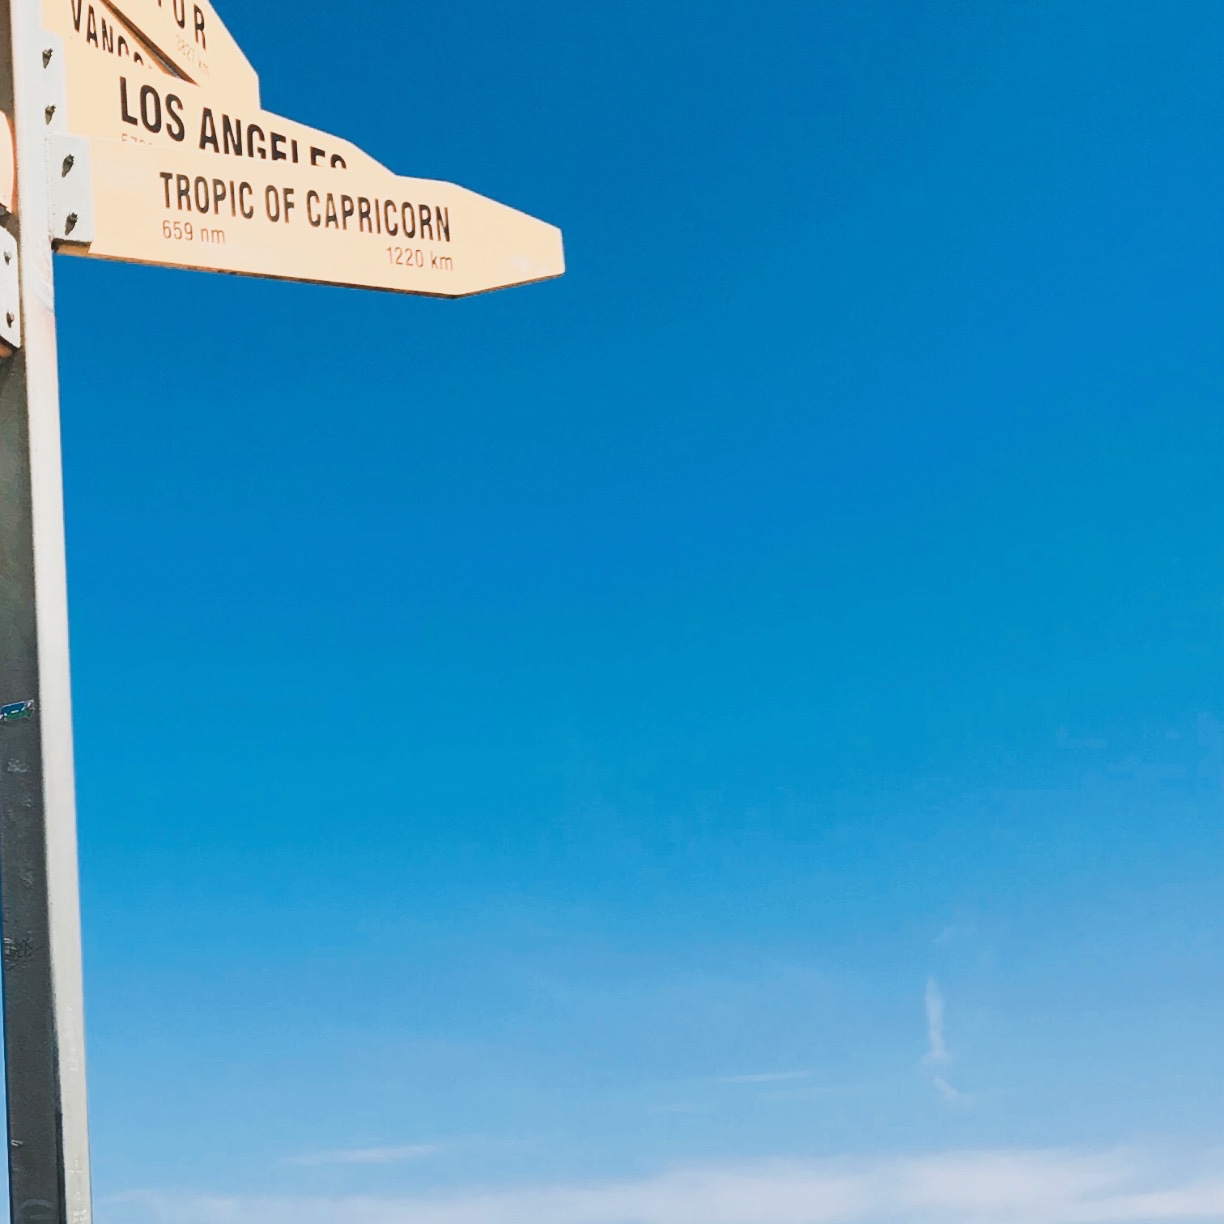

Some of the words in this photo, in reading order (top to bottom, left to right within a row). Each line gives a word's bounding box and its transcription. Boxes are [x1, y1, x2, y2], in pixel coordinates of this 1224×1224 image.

[119, 76, 185, 142] LOS
[160, 172, 254, 220] TROPIC
[265, 184, 295, 224] OF
[306, 189, 451, 243] CAPRICORN
[162, 219, 194, 242] 659
[200, 227, 226, 244] nm
[385, 246, 424, 268] 1220
[431, 250, 454, 271] km
